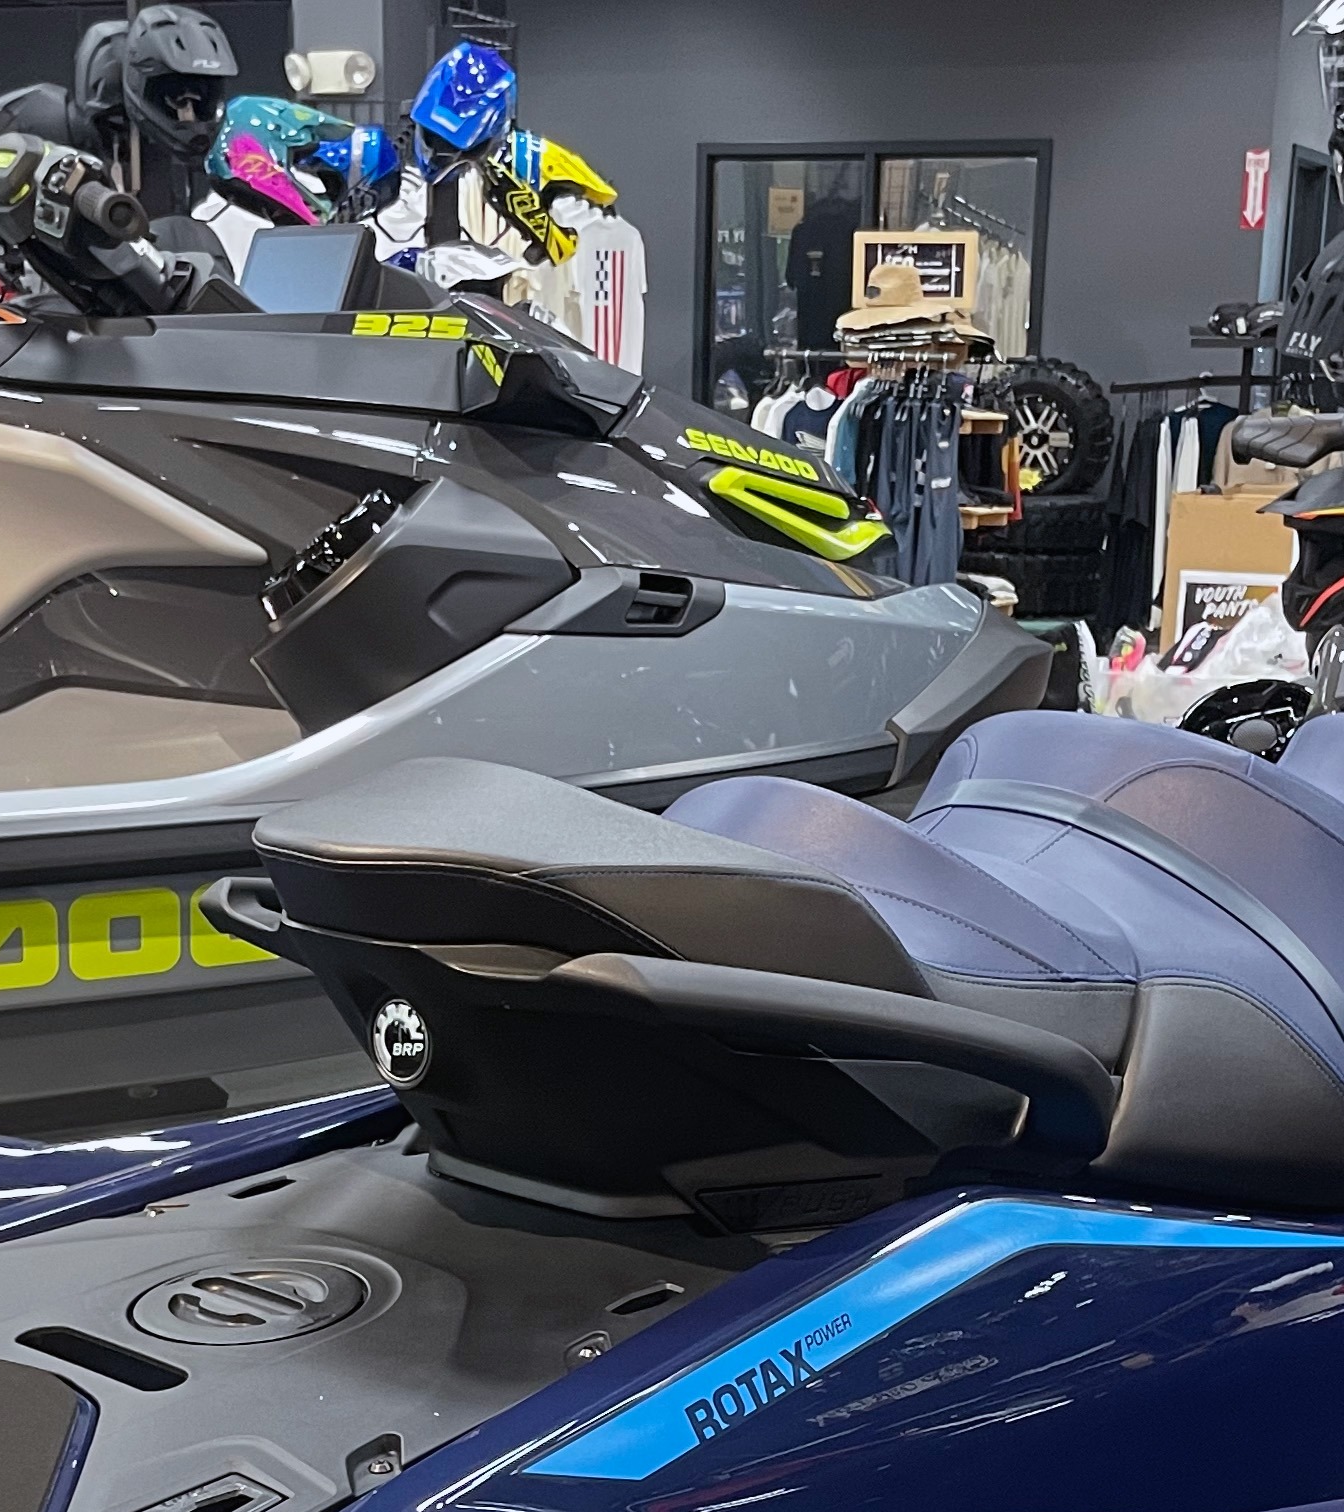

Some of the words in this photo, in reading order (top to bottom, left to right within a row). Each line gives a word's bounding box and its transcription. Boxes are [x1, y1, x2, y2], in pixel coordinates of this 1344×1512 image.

[352, 313, 469, 340] 325
[1288, 331, 1323, 352] FLY
[1194, 585, 1248, 604] YOUTH
[392, 1042, 424, 1057] BRP
[684, 1339, 819, 1446] ROTAX
[804, 1312, 853, 1352] POWER
